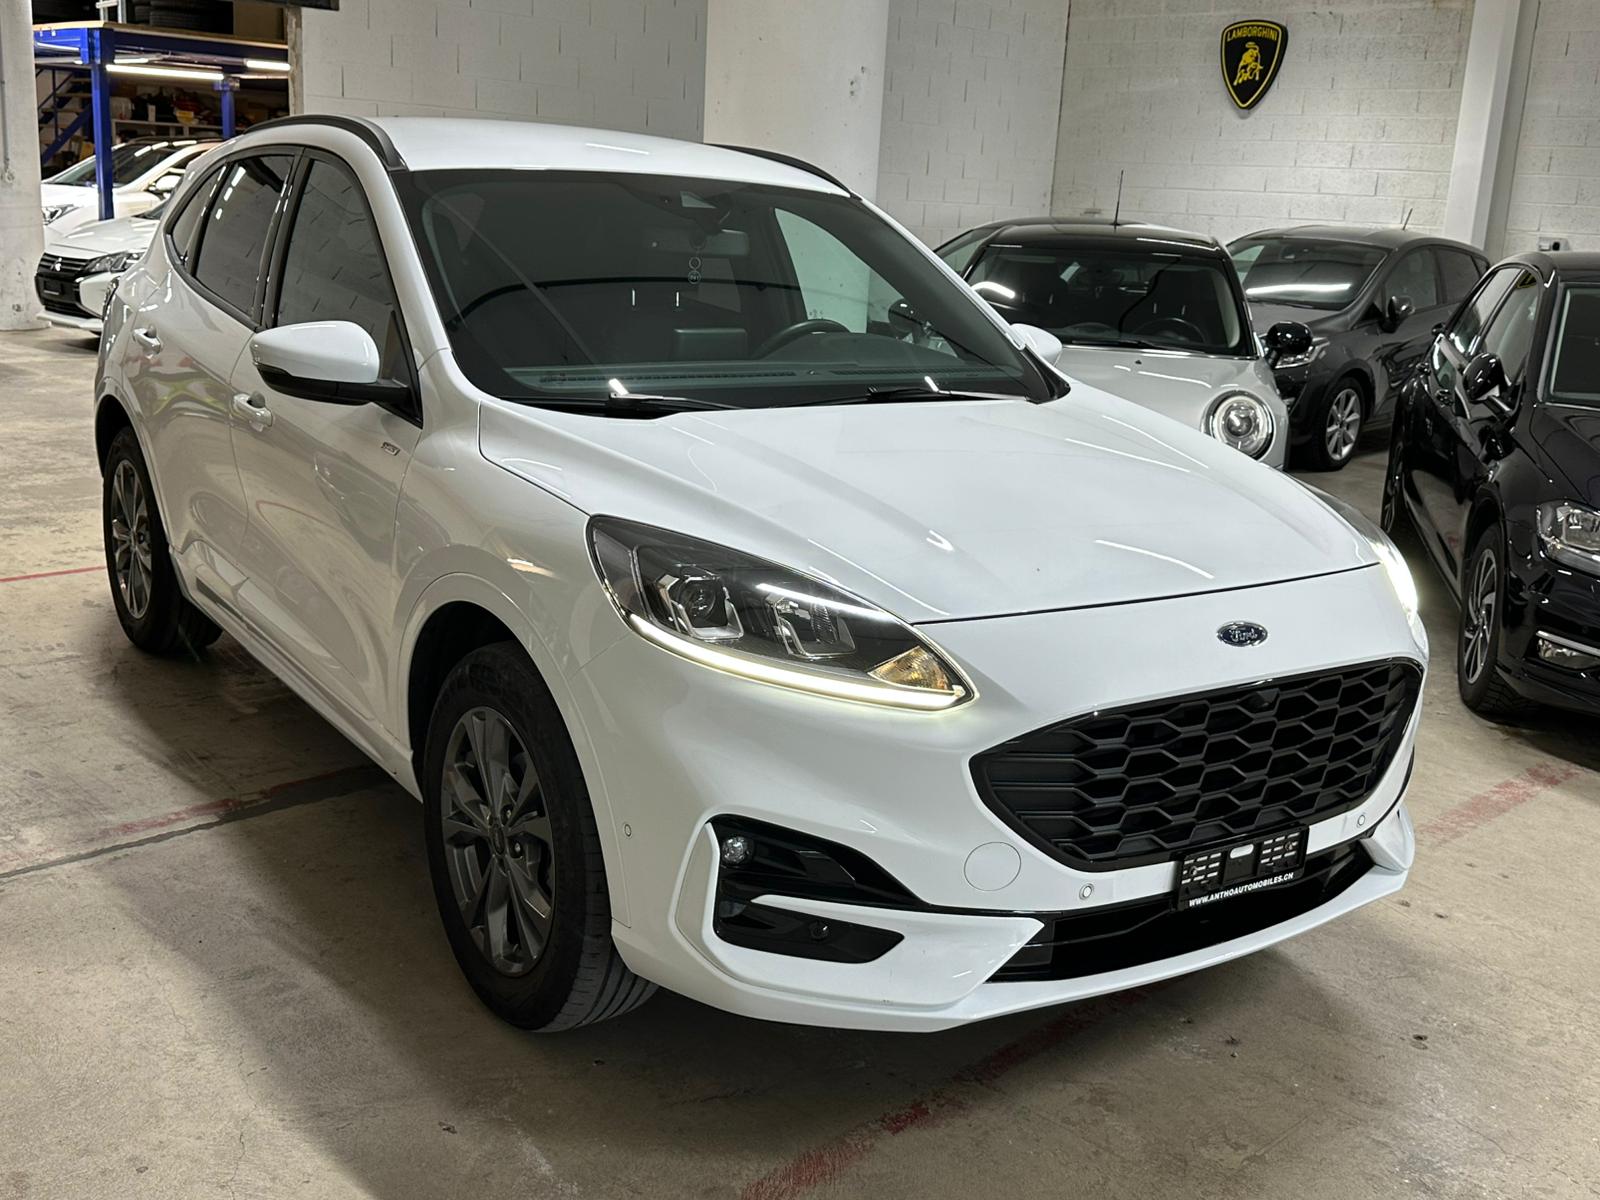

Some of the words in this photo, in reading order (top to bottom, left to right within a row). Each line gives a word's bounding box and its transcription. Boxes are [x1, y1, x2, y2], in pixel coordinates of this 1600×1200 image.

[1226, 26, 1278, 42] LAMBORGHINI
[1228, 627, 1258, 642] Ford
[1189, 872, 1294, 907] WWW.ANTHOAUTOMOBILES.CH
